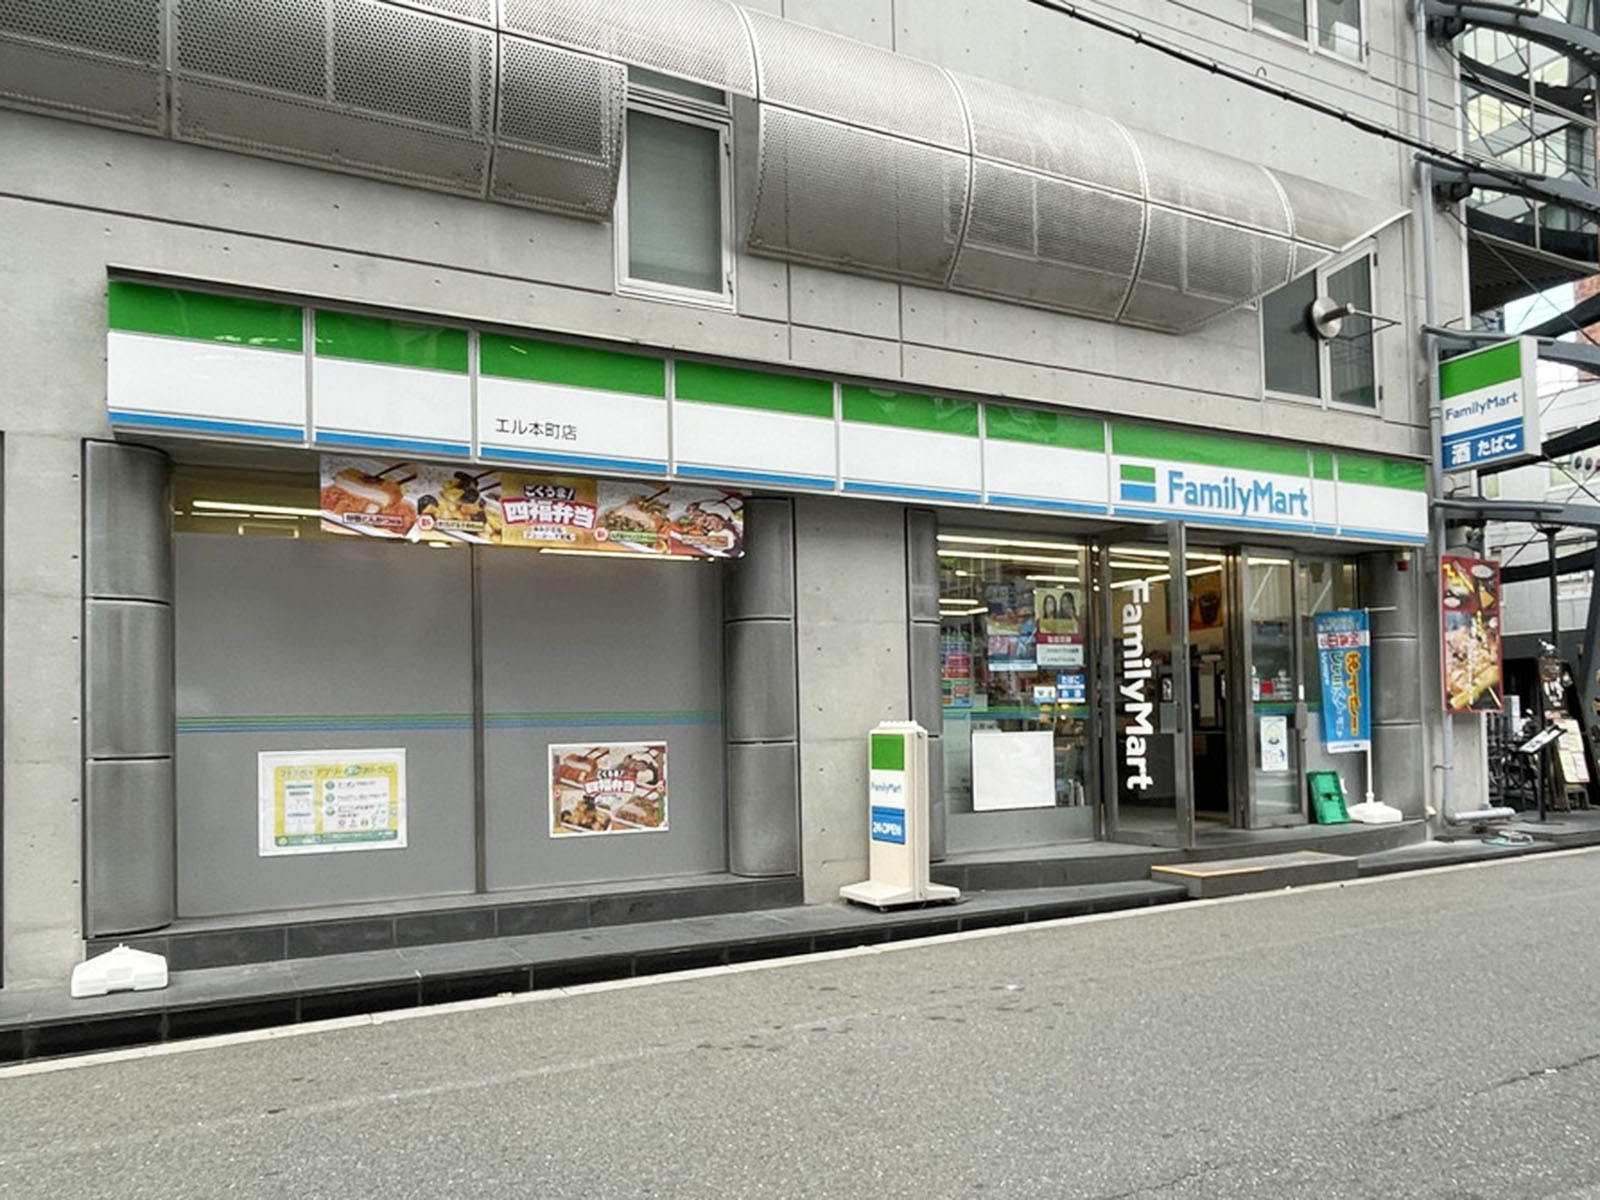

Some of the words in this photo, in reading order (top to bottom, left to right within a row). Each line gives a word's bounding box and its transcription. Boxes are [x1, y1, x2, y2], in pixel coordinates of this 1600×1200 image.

[1446, 392, 1518, 420] FamilyMart
[496, 418, 577, 440] エル本町店
[1452, 441, 1471, 465] 酒
[1477, 433, 1518, 457] たばこ
[1168, 470, 1308, 516] FamilyMart
[1120, 578, 1154, 790] FamilyMart
